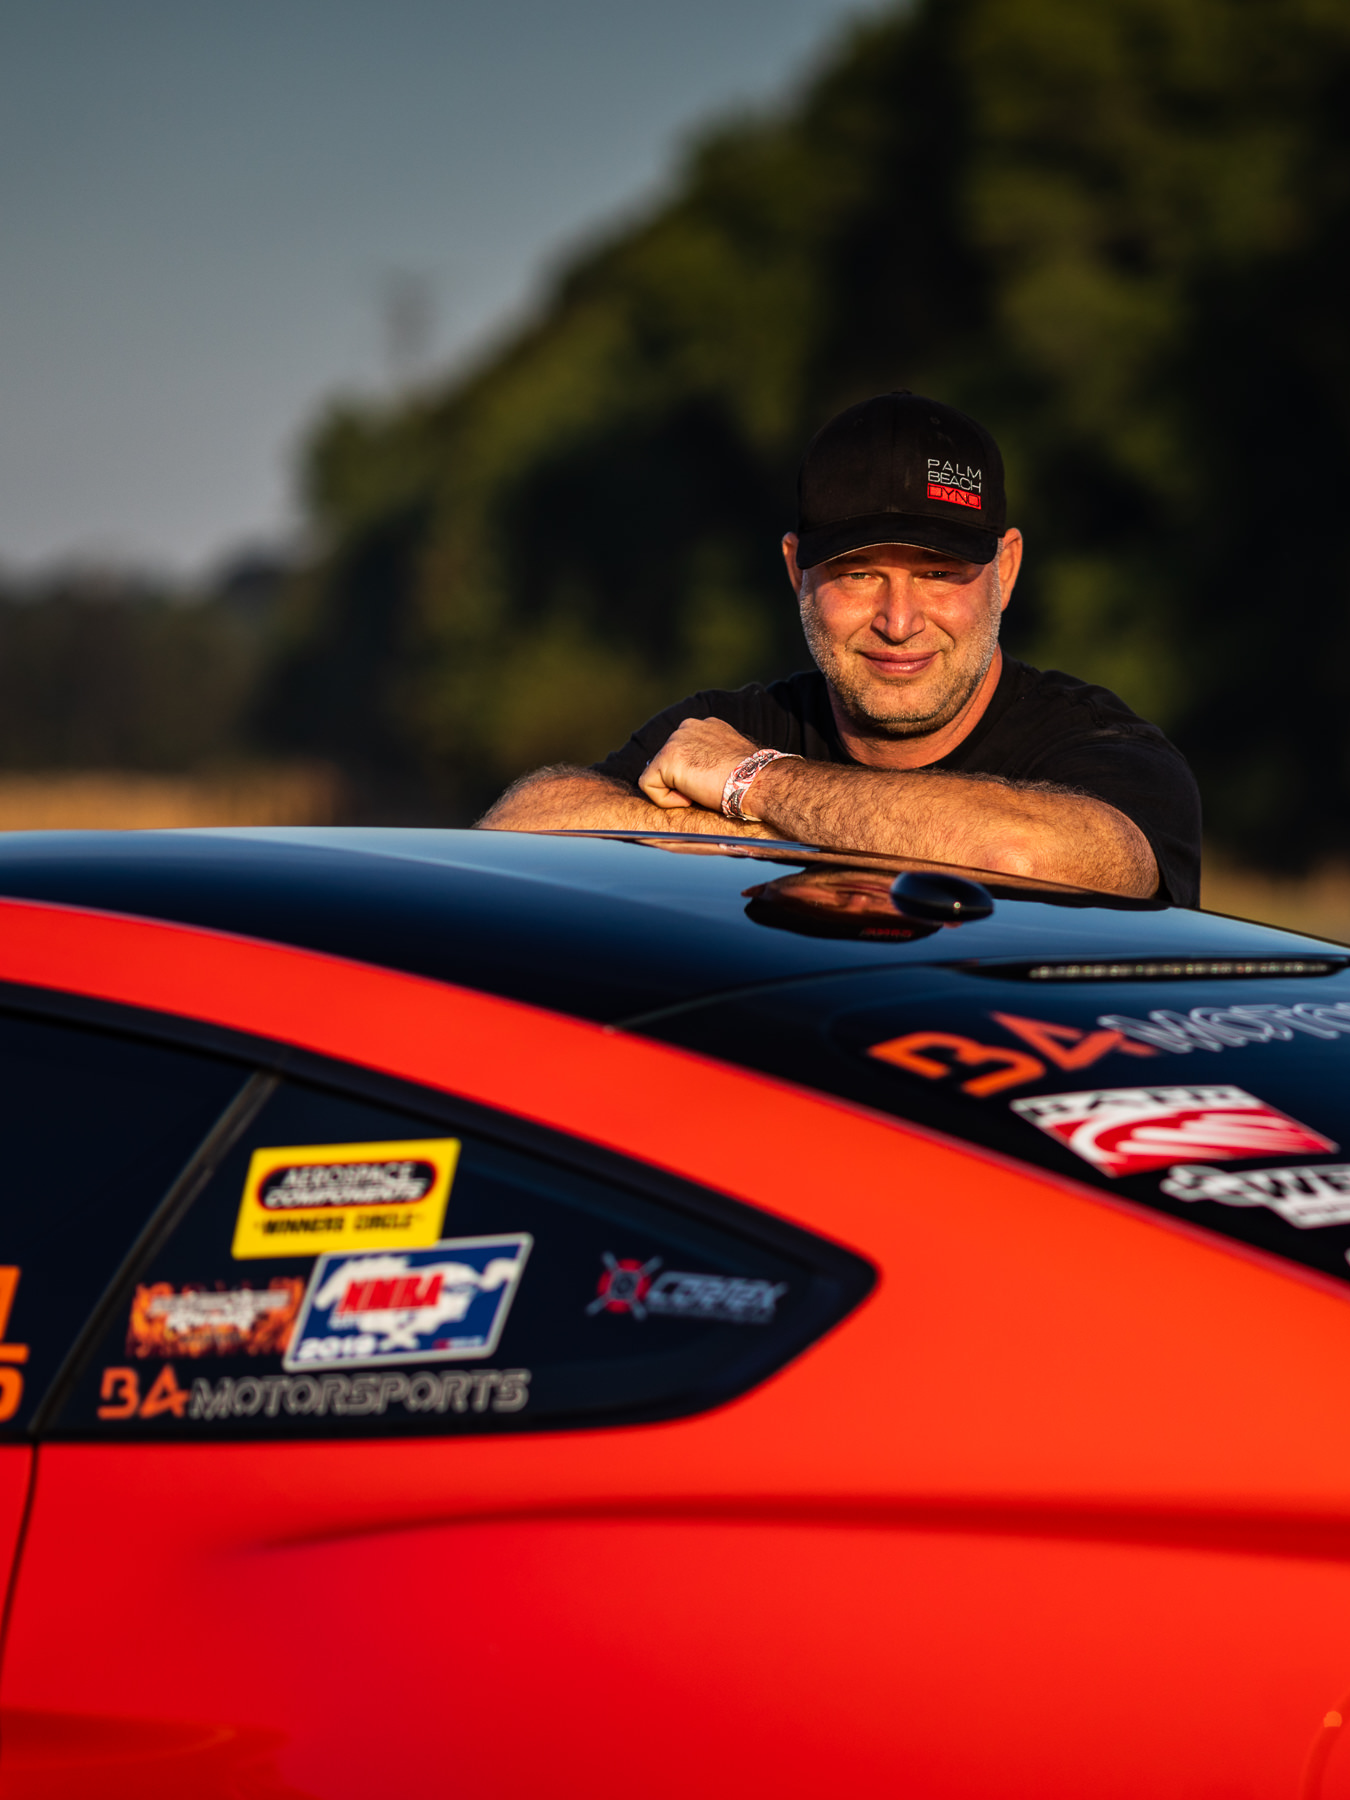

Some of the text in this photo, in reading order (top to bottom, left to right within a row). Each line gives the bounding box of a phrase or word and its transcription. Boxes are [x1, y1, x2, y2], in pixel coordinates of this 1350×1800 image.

[927, 458, 982, 480] PALM
[927, 470, 982, 493] BEACH
[928, 484, 981, 509] DYNO
[280, 1161, 416, 1188] AEROSPACE
[264, 1178, 430, 1208] COMPONENTS
[336, 1271, 445, 1314] NMRA
[188, 1367, 532, 1420] MOTORSPORTS
